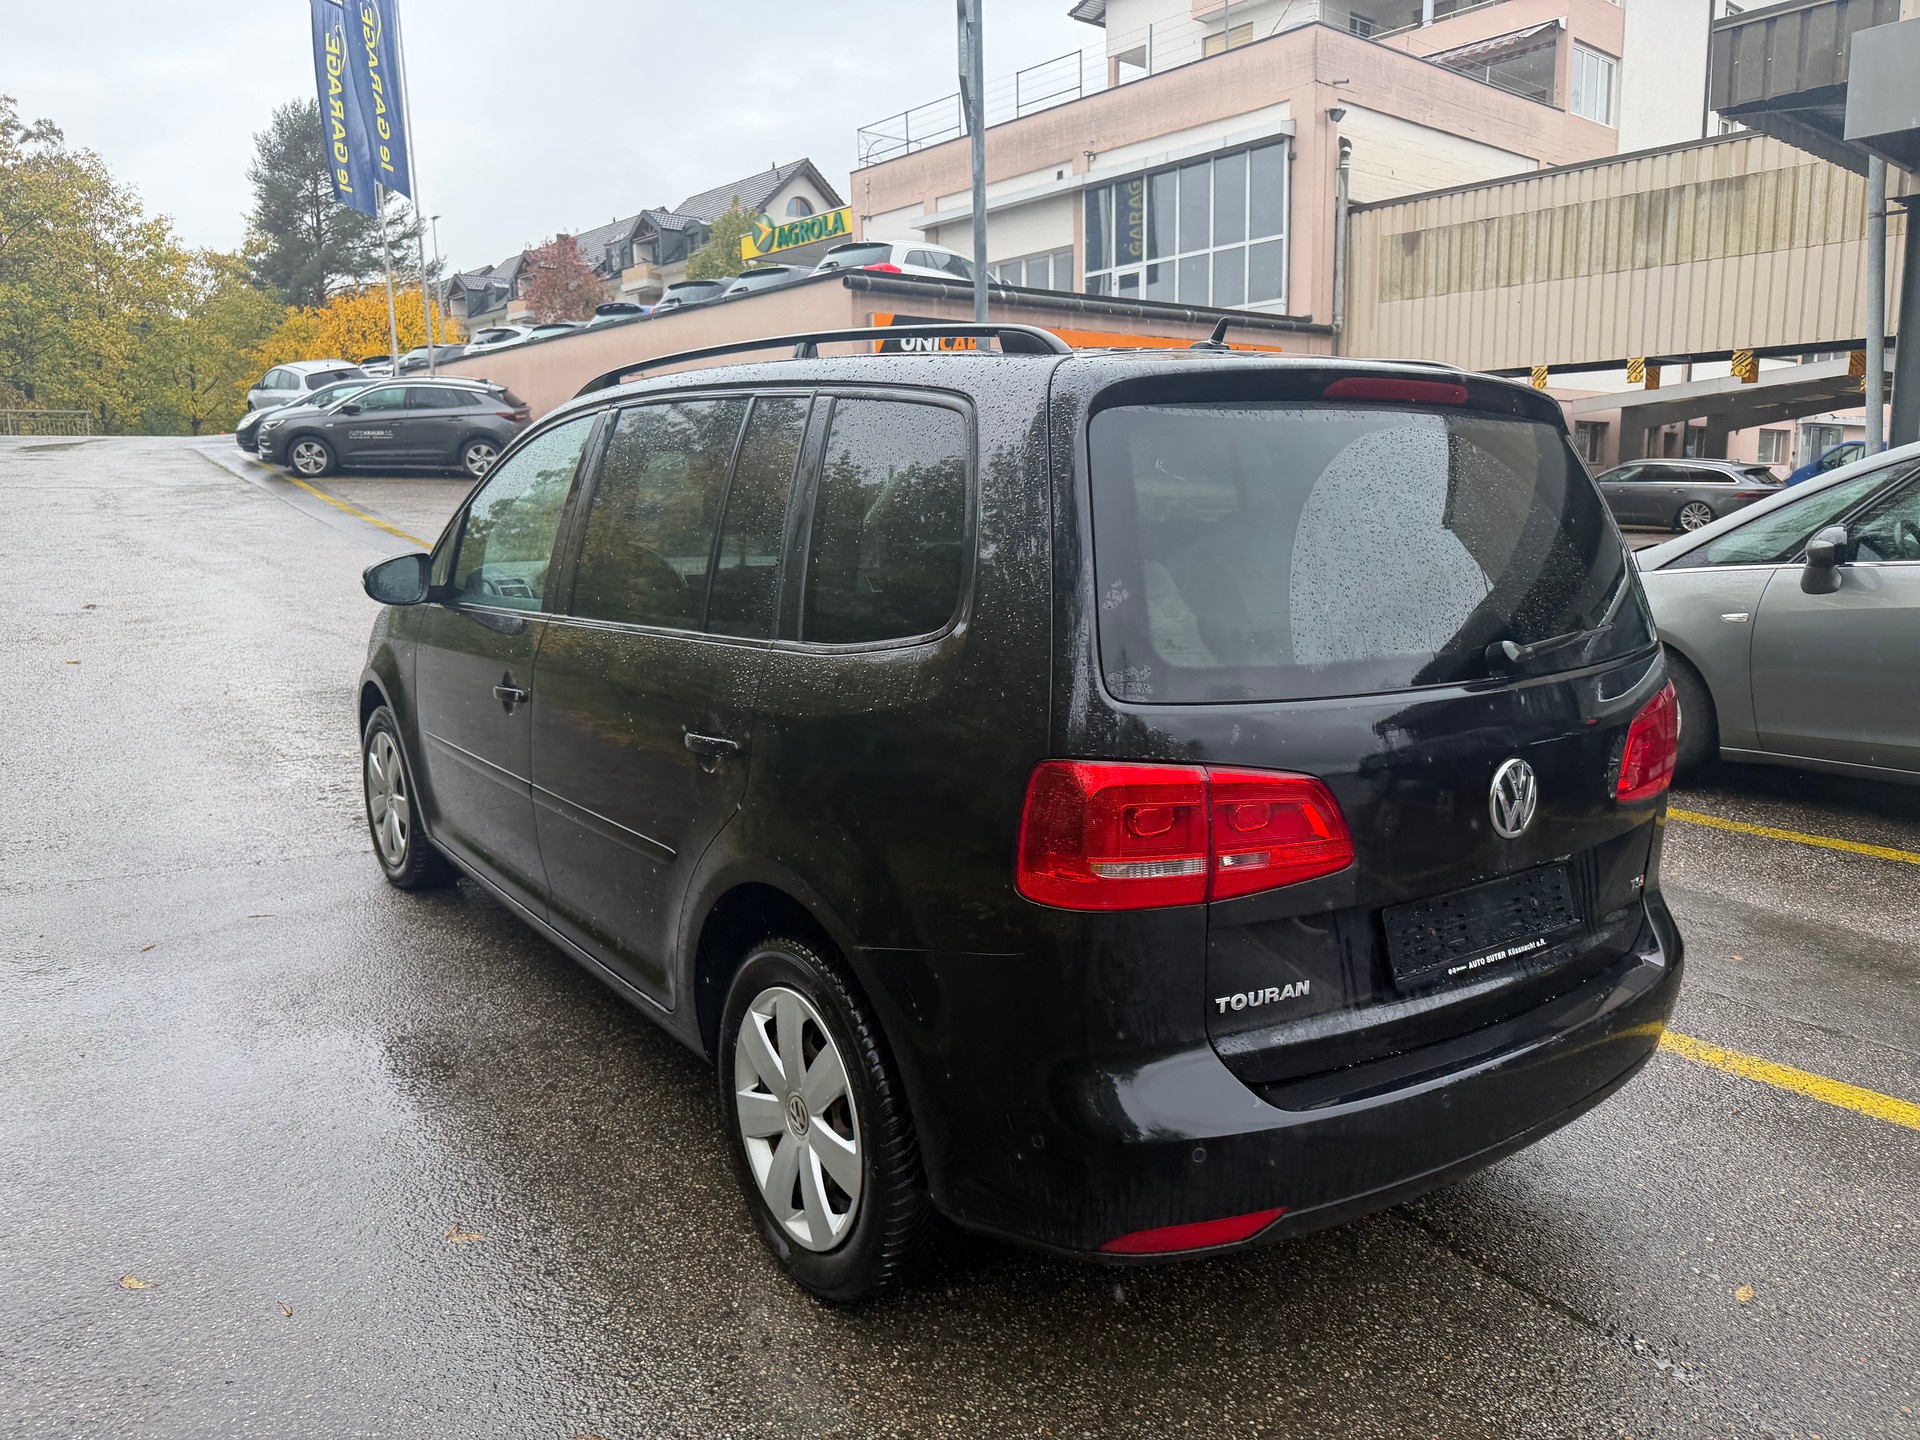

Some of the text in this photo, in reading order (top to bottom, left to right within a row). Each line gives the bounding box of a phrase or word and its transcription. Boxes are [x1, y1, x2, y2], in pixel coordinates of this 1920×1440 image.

[776, 211, 846, 249] AGROLA
[1468, 958, 1486, 970] AUTO
[1486, 950, 1507, 964] SUTER
[1214, 980, 1310, 1014] TOURAN
